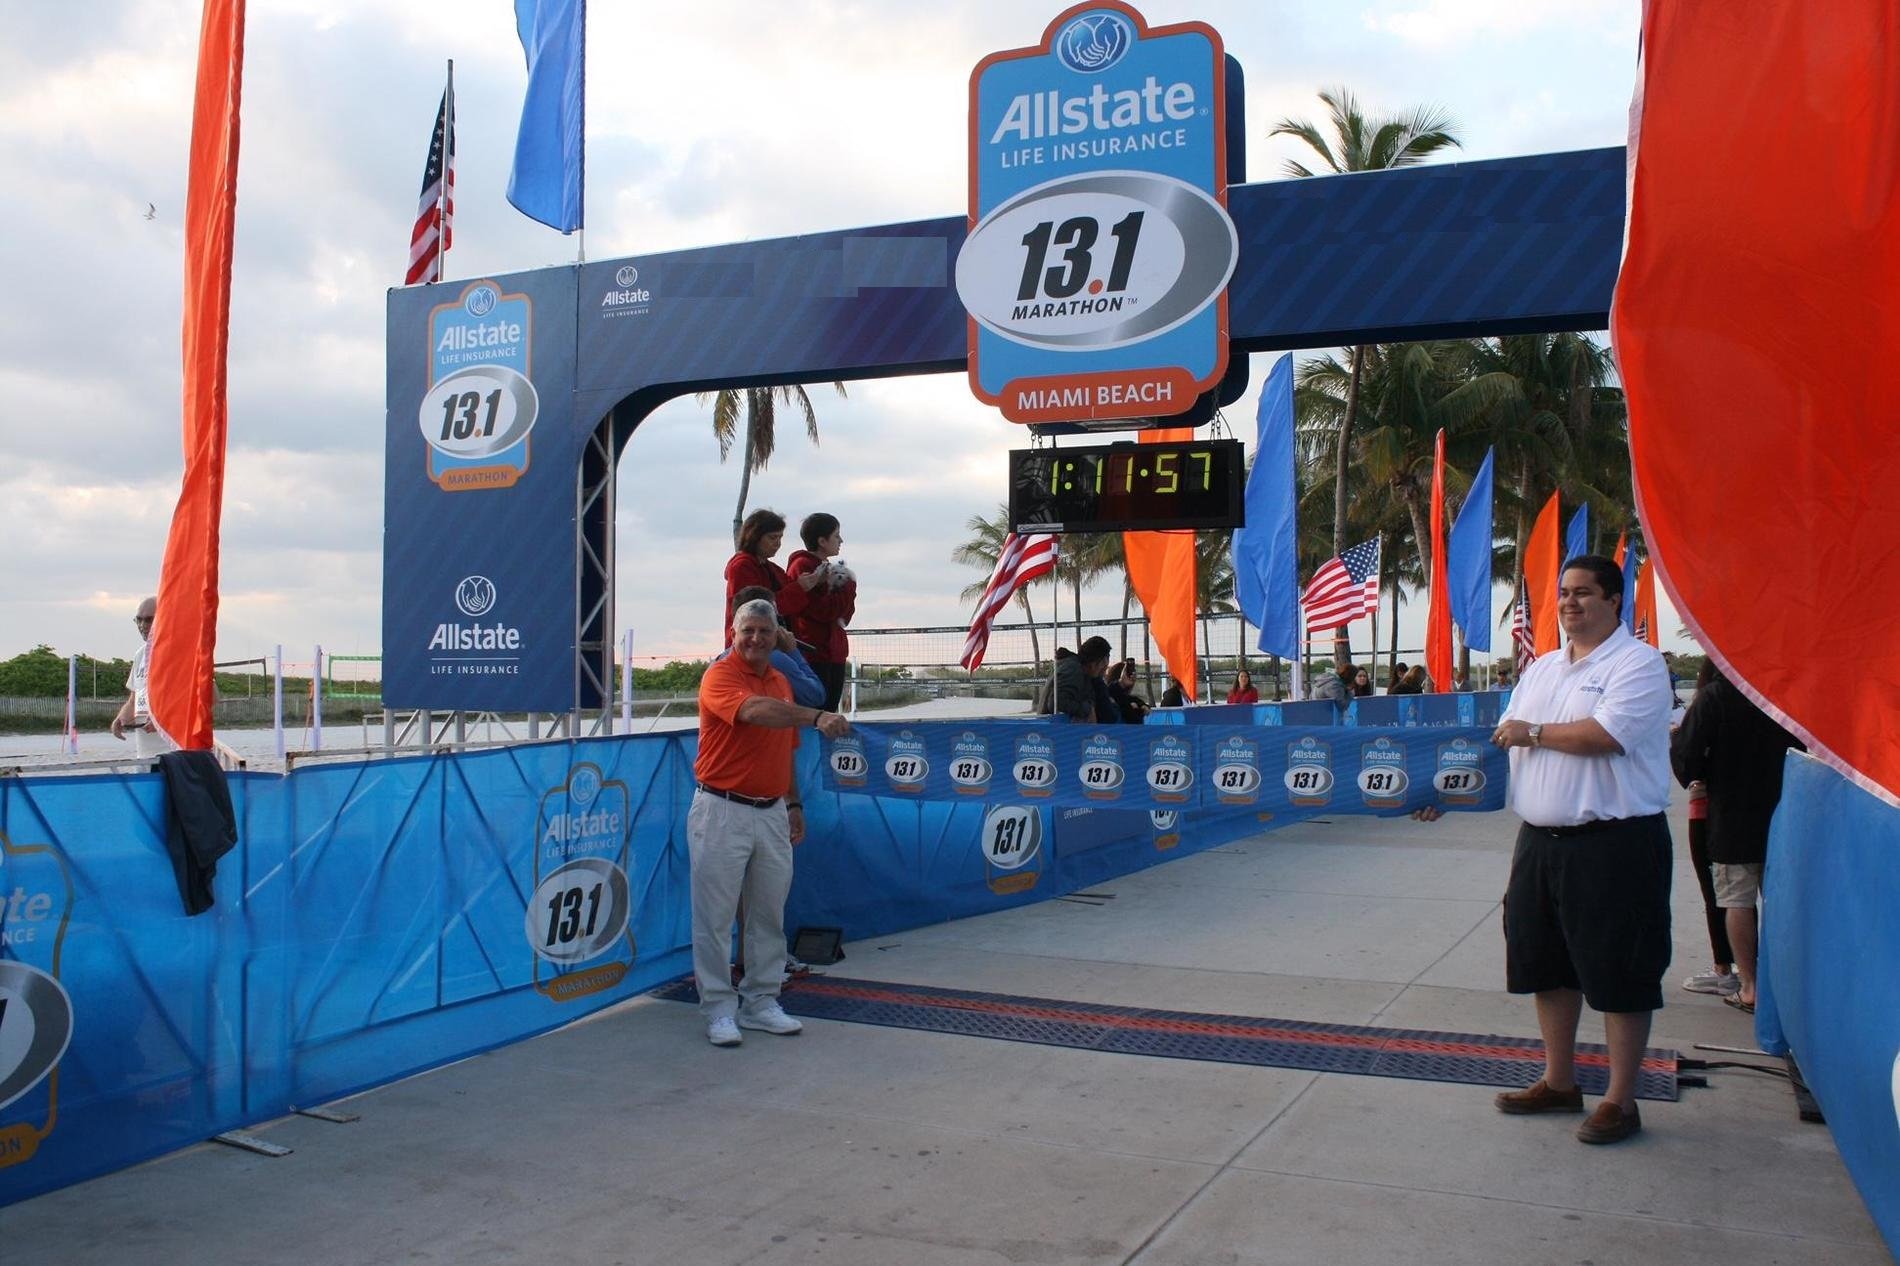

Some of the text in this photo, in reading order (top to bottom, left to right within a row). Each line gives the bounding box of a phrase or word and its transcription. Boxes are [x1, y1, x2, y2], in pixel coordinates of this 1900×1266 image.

[990, 76, 1195, 144] Allstate
[1002, 129, 1186, 168] LIFE INSURANCE
[1017, 211, 1145, 301] 13.1
[602, 288, 650, 306] Allstate
[1011, 297, 1123, 320] MARATHON
[437, 320, 520, 352] Allstate
[441, 347, 517, 364] LIFE INSURANCE
[1018, 381, 1173, 410] MIAMI BEACH
[441, 388, 502, 441] 13.1
[447, 470, 508, 485] MARATHON
[428, 623, 520, 650] Allstate
[431, 665, 519, 674] LIFE INSURANCE
[892, 740, 923, 750] Allstate
[955, 743, 985, 752] Allstate
[1019, 744, 1050, 753] Allstate
[1085, 746, 1118, 755] Allstate
[1153, 748, 1187, 757] Allstate
[1220, 749, 1254, 758] Allstate
[1291, 750, 1327, 759] Allstate
[1365, 751, 1400, 760] Allstate
[1441, 751, 1478, 761] Allstate
[837, 756, 857, 771] 13.1
[893, 761, 917, 776] 13.1
[957, 763, 980, 778] 13.1
[1021, 765, 1044, 780] 13.1
[1087, 767, 1110, 783] 13.1
[1155, 769, 1179, 785] 13.1
[1221, 771, 1246, 787] 13.1
[1293, 772, 1319, 788] 13.1
[1367, 773, 1393, 790] 13.1
[1443, 774, 1470, 789] 13.1
[543, 810, 619, 844] Allstate
[993, 816, 1027, 855] 13.1
[546, 837, 617, 858] LIFE INSURANCE
[546, 883, 603, 947] 13.1
[557, 970, 620, 994] MARATHON
